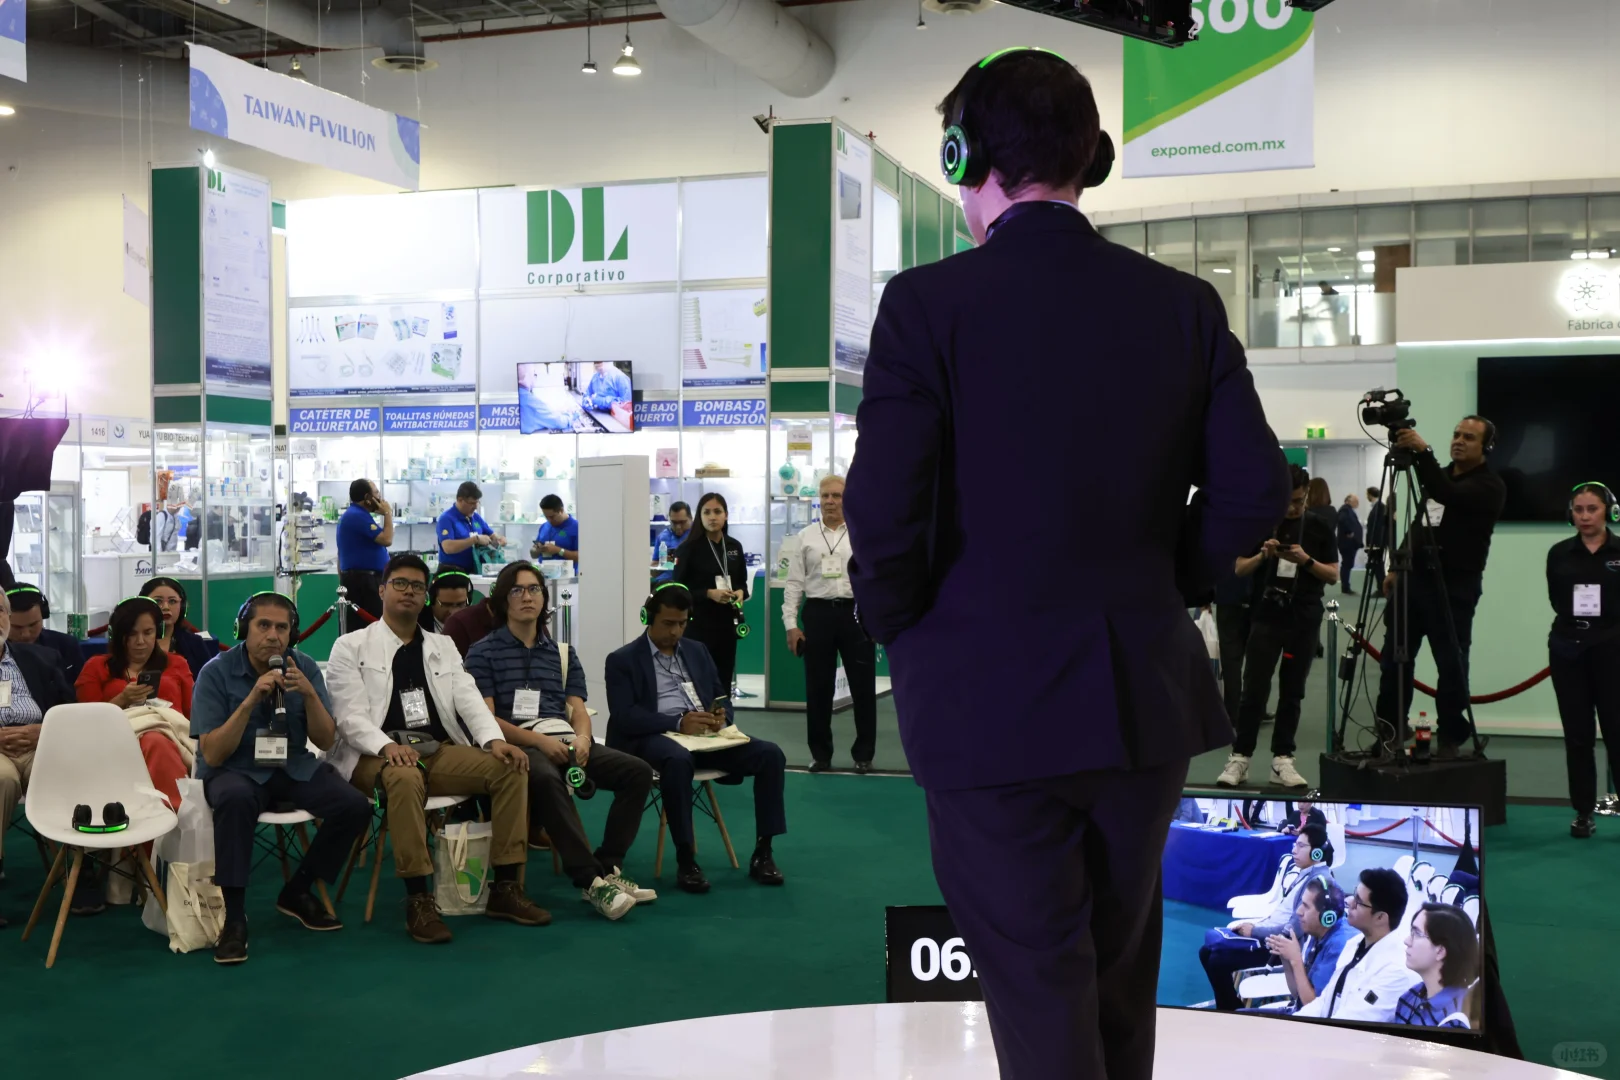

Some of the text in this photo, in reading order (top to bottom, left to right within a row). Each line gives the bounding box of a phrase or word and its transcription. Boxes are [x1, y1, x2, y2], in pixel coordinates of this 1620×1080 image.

[243, 94, 376, 152] TAIWAN PAVILION
[1151, 139, 1286, 158] expomed.com.mx
[207, 168, 226, 193] DL
[526, 186, 629, 265] DL
[527, 268, 626, 285] Corporativo
[1568, 319, 1614, 331] Fábrica
[634, 401, 678, 412] DE BAJO
[694, 400, 766, 412] BOMBAS D
[299, 408, 371, 420] CATÉTER DE
[385, 410, 475, 421] TOALLITAS HÚMEDAS
[293, 420, 378, 432] POLIURETANO
[391, 420, 469, 429] ANTIBACTERIALES
[91, 427, 106, 437] 1416
[138, 430, 150, 439] YUA
